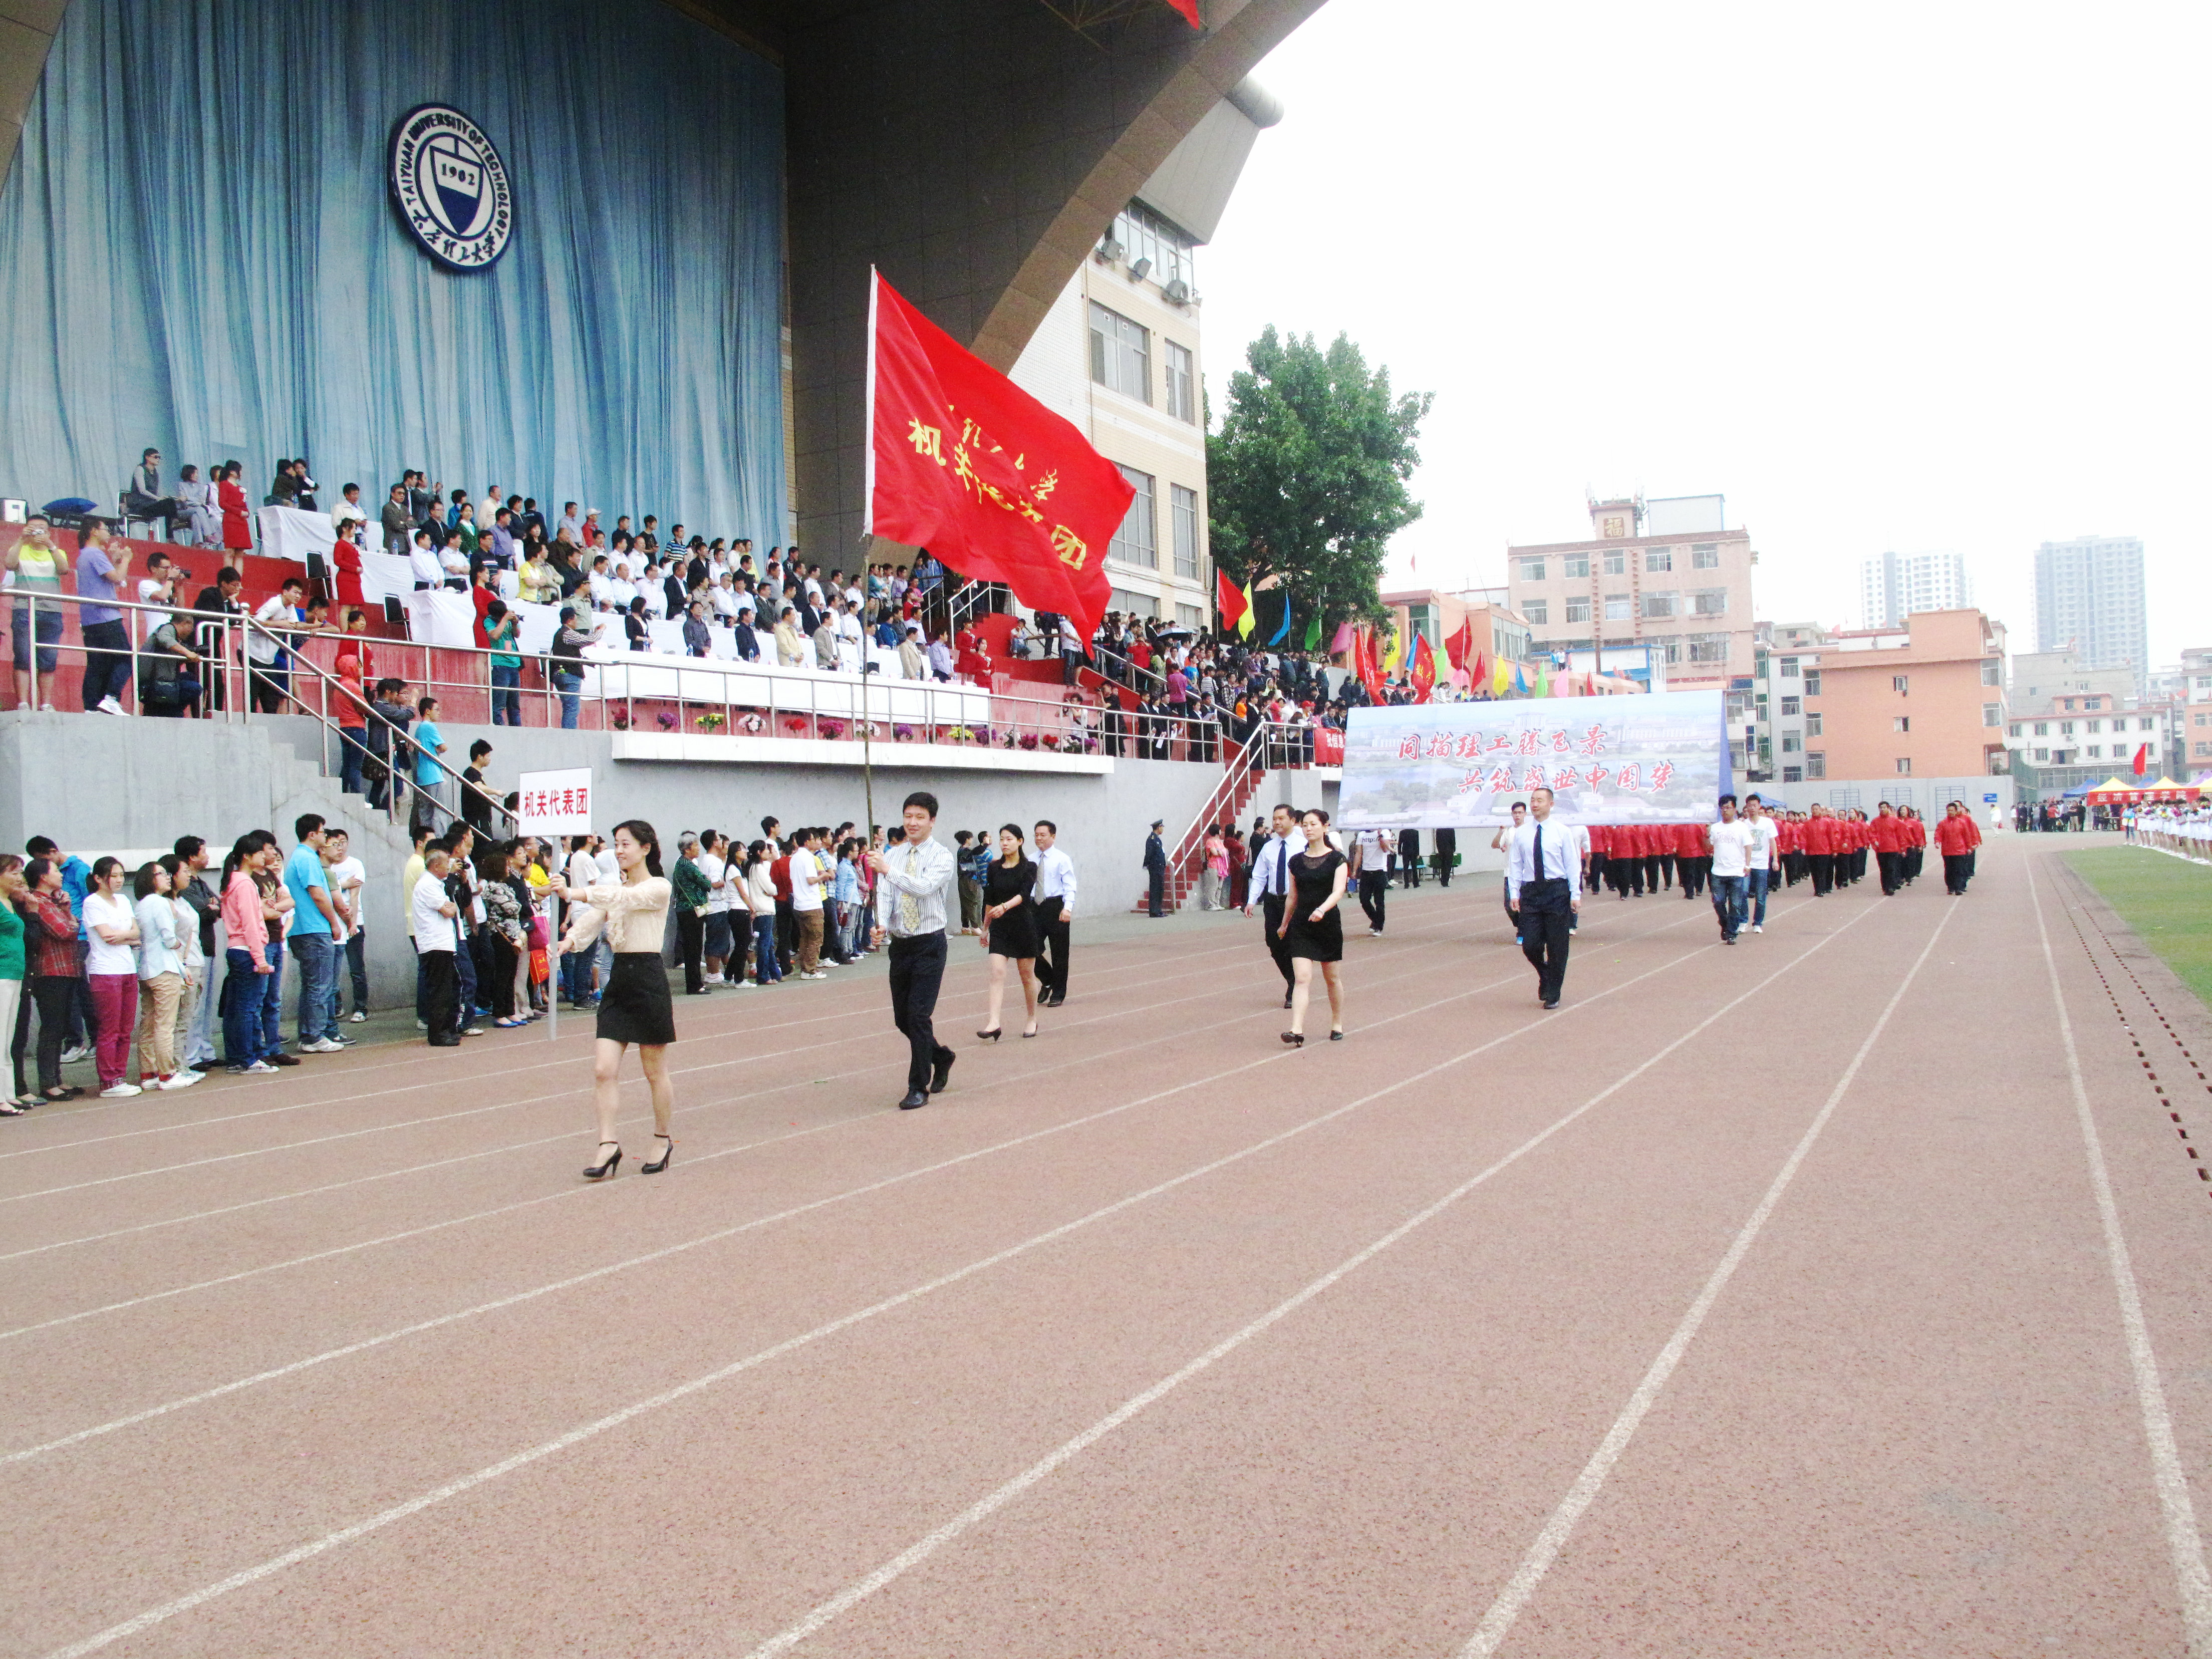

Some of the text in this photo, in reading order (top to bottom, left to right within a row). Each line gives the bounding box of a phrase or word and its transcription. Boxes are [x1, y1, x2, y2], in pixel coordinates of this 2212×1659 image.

[401, 113, 509, 239] TAIYUAN UNIVERSITY OF TECHNOLOGY
[441, 163, 475, 186] 1902
[1604, 518, 1623, 537] 福
[1457, 759, 1676, 795] 共筑盛世中国梦
[524, 787, 588, 817] 机关代表团
[2097, 790, 2186, 802] 经济管理学院
